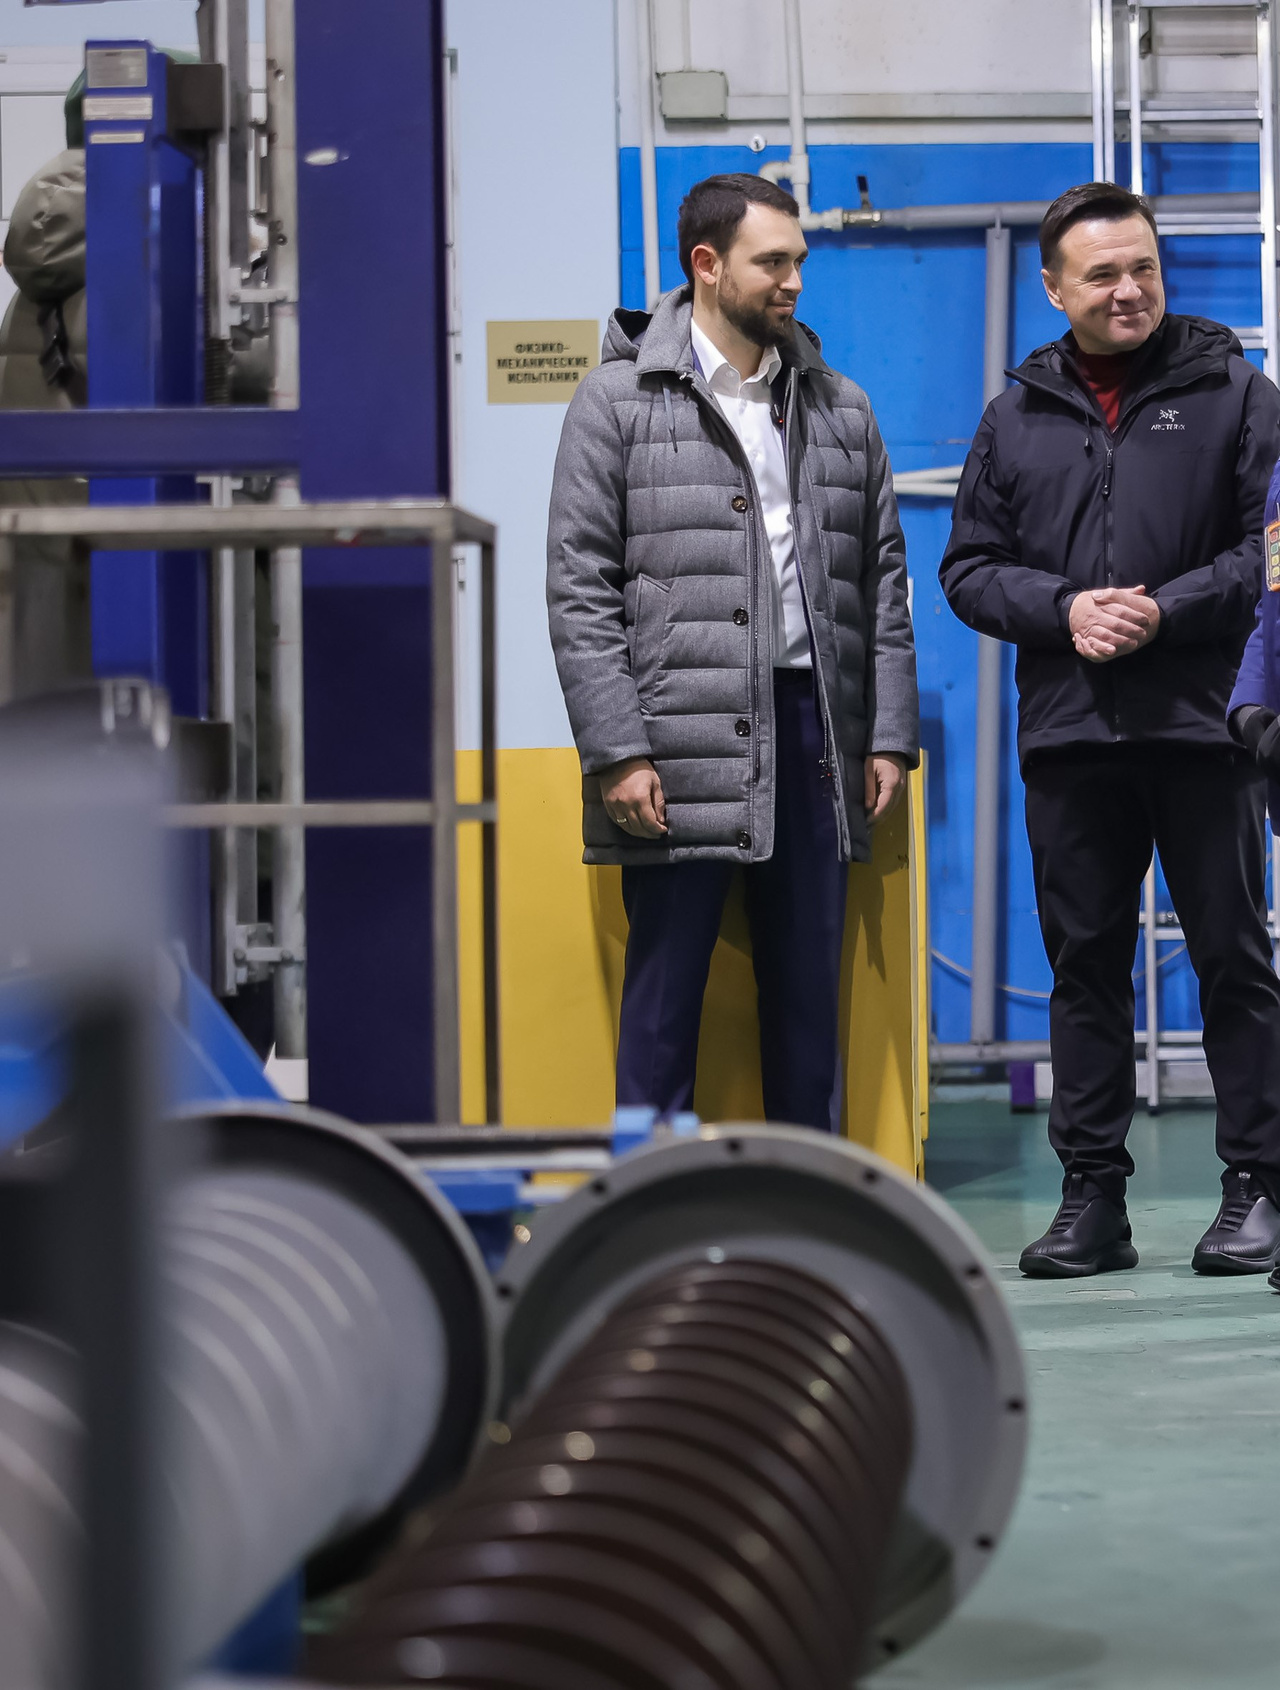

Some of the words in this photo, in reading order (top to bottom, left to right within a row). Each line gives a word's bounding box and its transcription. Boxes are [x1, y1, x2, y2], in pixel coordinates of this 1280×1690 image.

[515, 342, 570, 354] ФИЗИКО-
[497, 357, 589, 369] МЕХАНИЧЕСКИЕ
[508, 372, 579, 384] ИСПЫТАНИЯ
